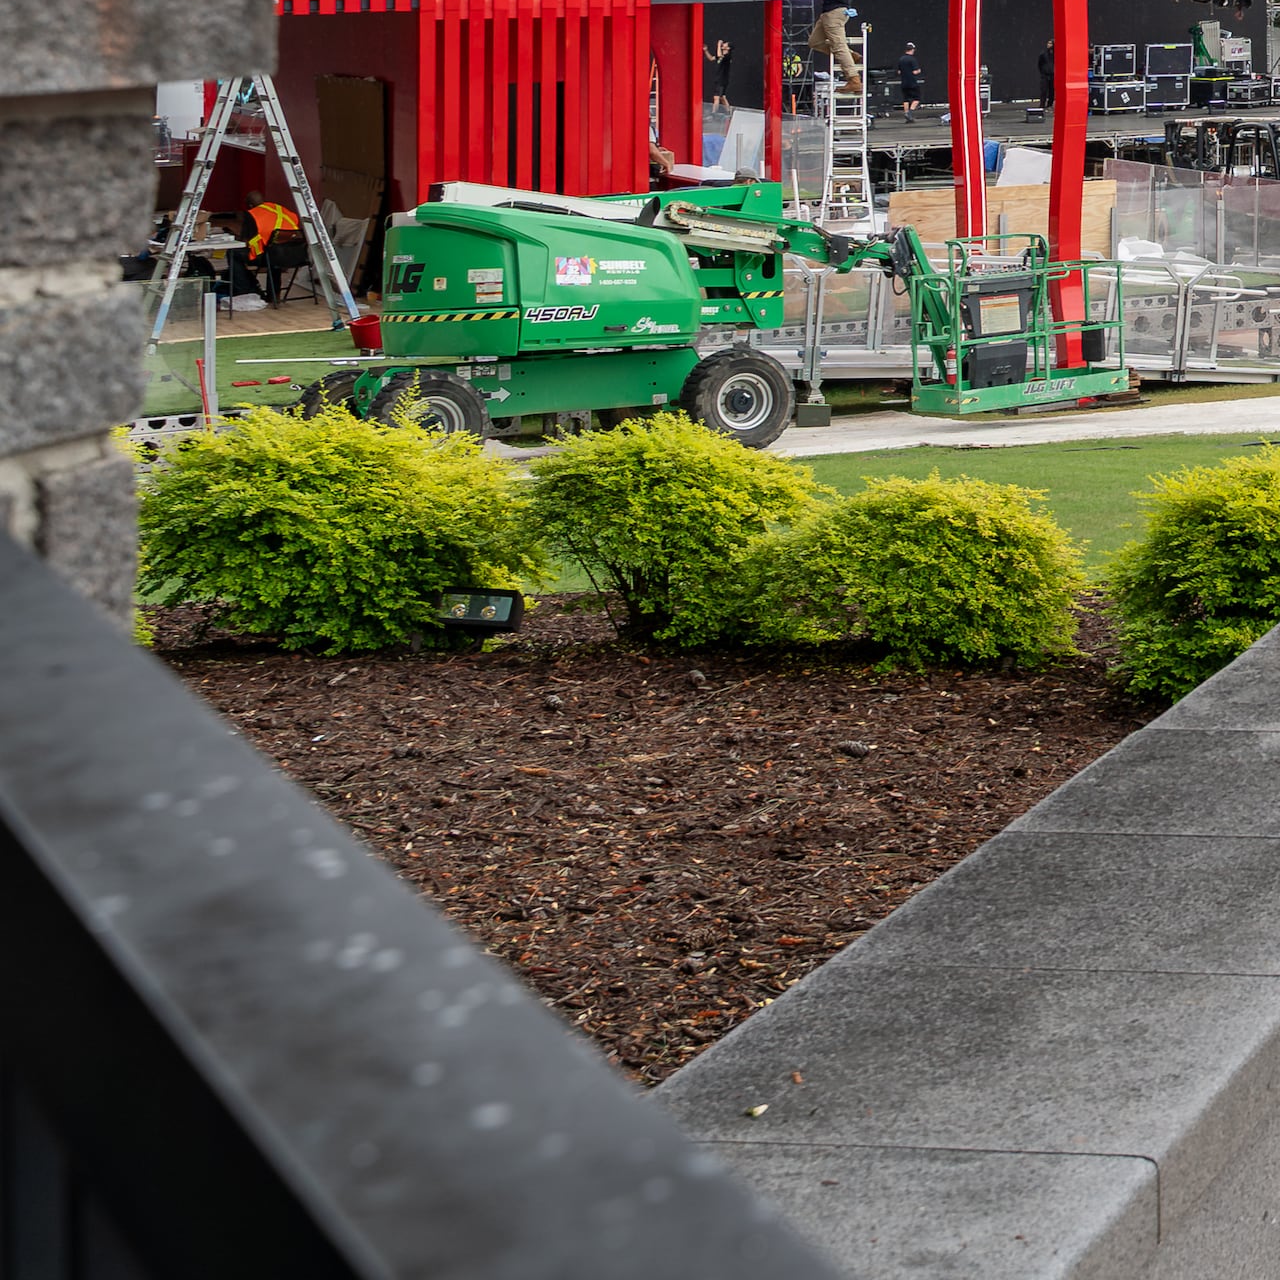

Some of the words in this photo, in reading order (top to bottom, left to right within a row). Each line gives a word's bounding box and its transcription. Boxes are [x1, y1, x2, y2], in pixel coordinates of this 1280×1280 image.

[385, 263, 426, 294] JLG
[525, 304, 600, 323] 450AJ
[1024, 382, 1046, 395] JLG
[1049, 378, 1076, 391] LIFT
